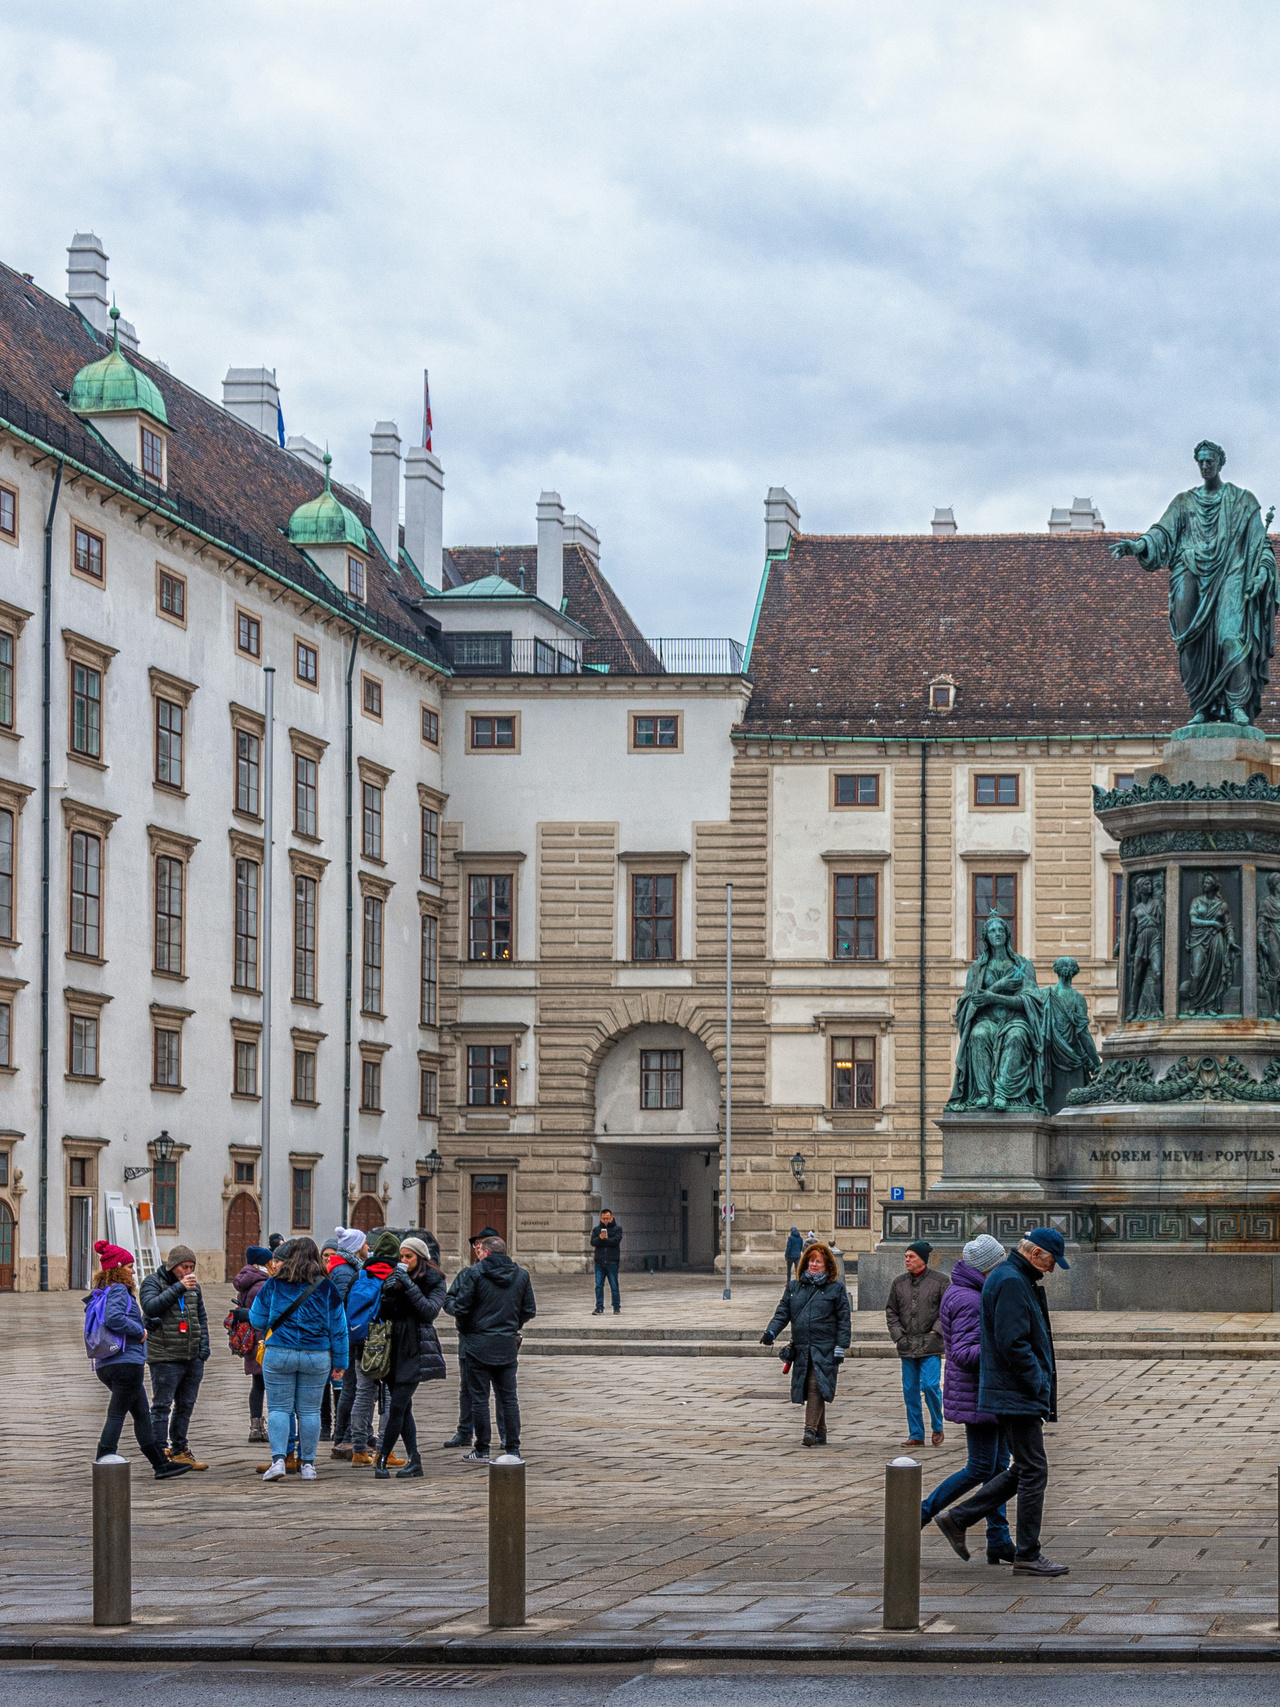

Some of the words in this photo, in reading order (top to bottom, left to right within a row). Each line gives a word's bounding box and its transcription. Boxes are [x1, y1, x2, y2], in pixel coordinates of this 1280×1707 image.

[1089, 1150, 1151, 1162] AMOREM
[1162, 1150, 1204, 1162] MEVM
[1215, 1150, 1275, 1162] POPVLIS
[893, 1188, 902, 1200] P
